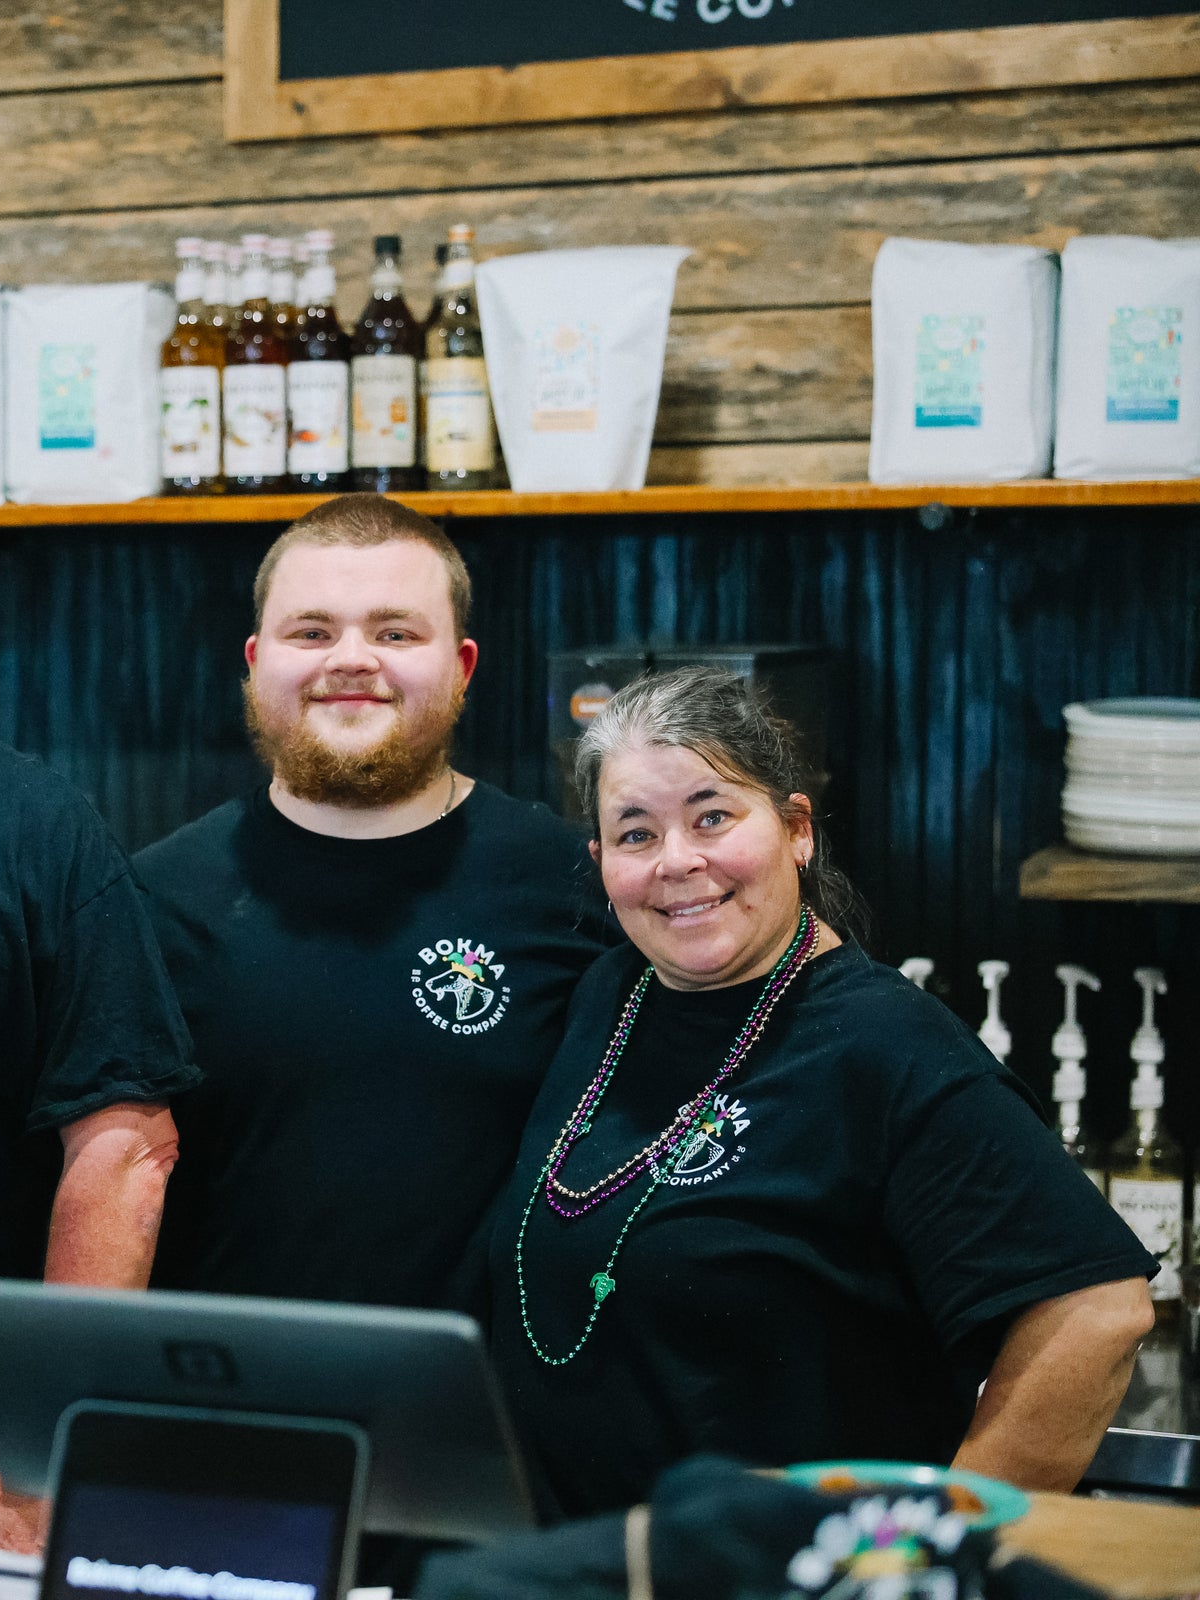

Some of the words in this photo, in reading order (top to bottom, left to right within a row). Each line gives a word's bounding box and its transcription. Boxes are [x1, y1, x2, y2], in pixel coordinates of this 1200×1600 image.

[418, 938, 505, 980] BOKMA
[412, 987, 449, 1030] COFFEE
[451, 1002, 506, 1035] COMPANY
[661, 1162, 731, 1187] COMPANY
